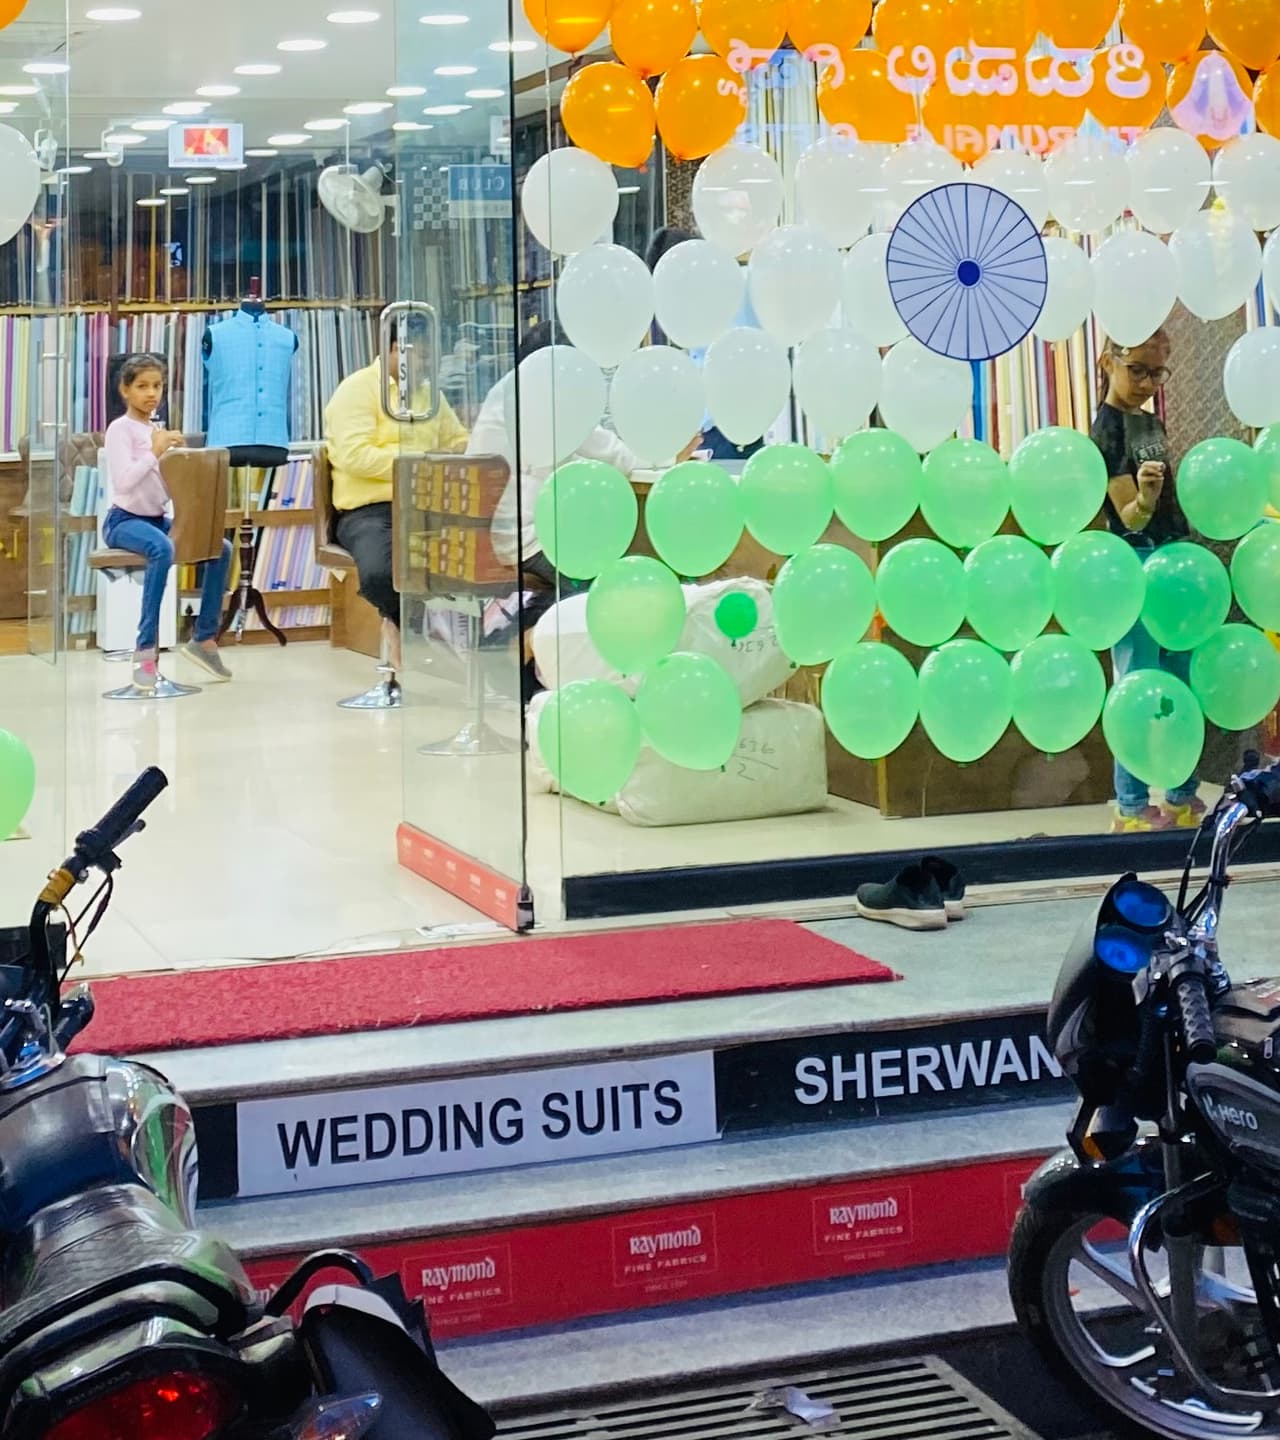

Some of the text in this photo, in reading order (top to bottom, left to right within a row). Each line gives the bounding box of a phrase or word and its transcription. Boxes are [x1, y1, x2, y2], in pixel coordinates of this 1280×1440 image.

[277, 1078, 684, 1171] WEDDING SUITS
[829, 1196, 898, 1229] Raymond
[629, 1224, 702, 1259] Raymond
[422, 1255, 496, 1292] Raymond
